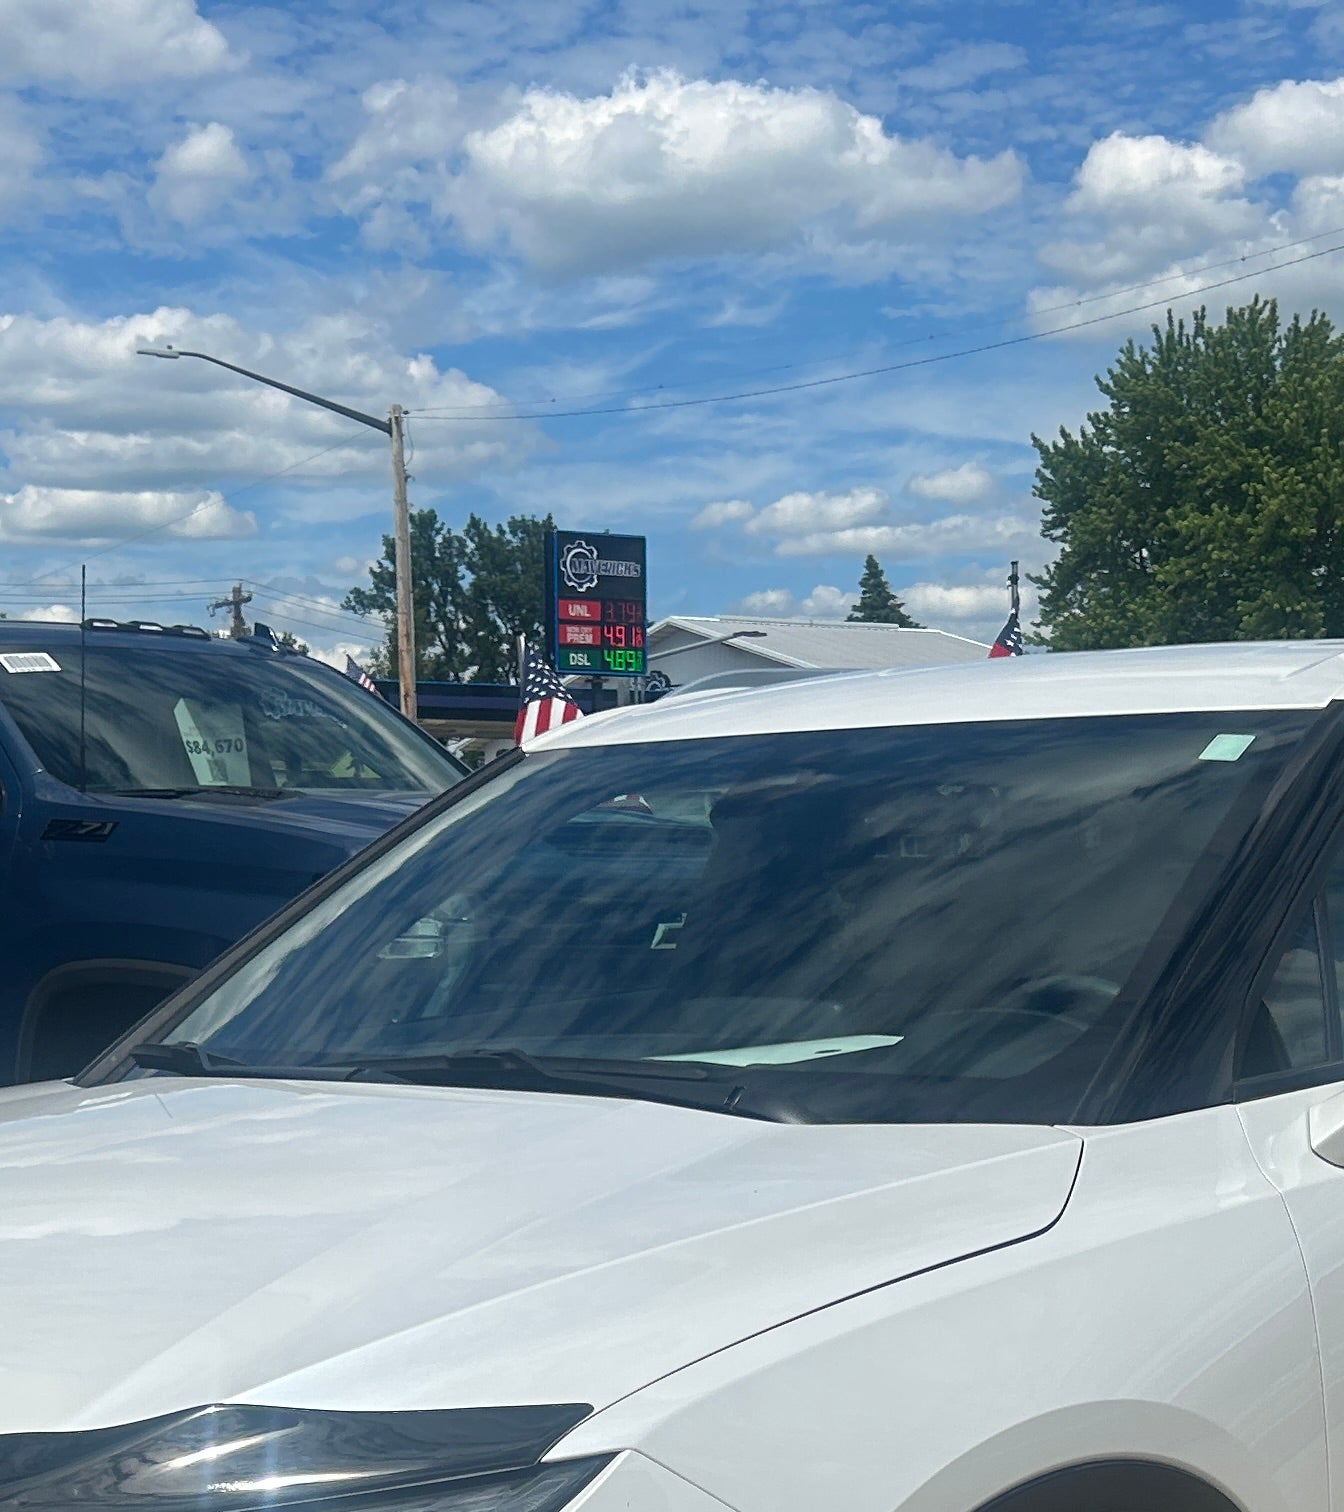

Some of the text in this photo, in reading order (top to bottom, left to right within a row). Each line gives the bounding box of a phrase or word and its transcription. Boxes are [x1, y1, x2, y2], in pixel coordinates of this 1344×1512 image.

[568, 604, 591, 616] UNL
[569, 653, 591, 666] DSL
[185, 737, 244, 757] $84,670
